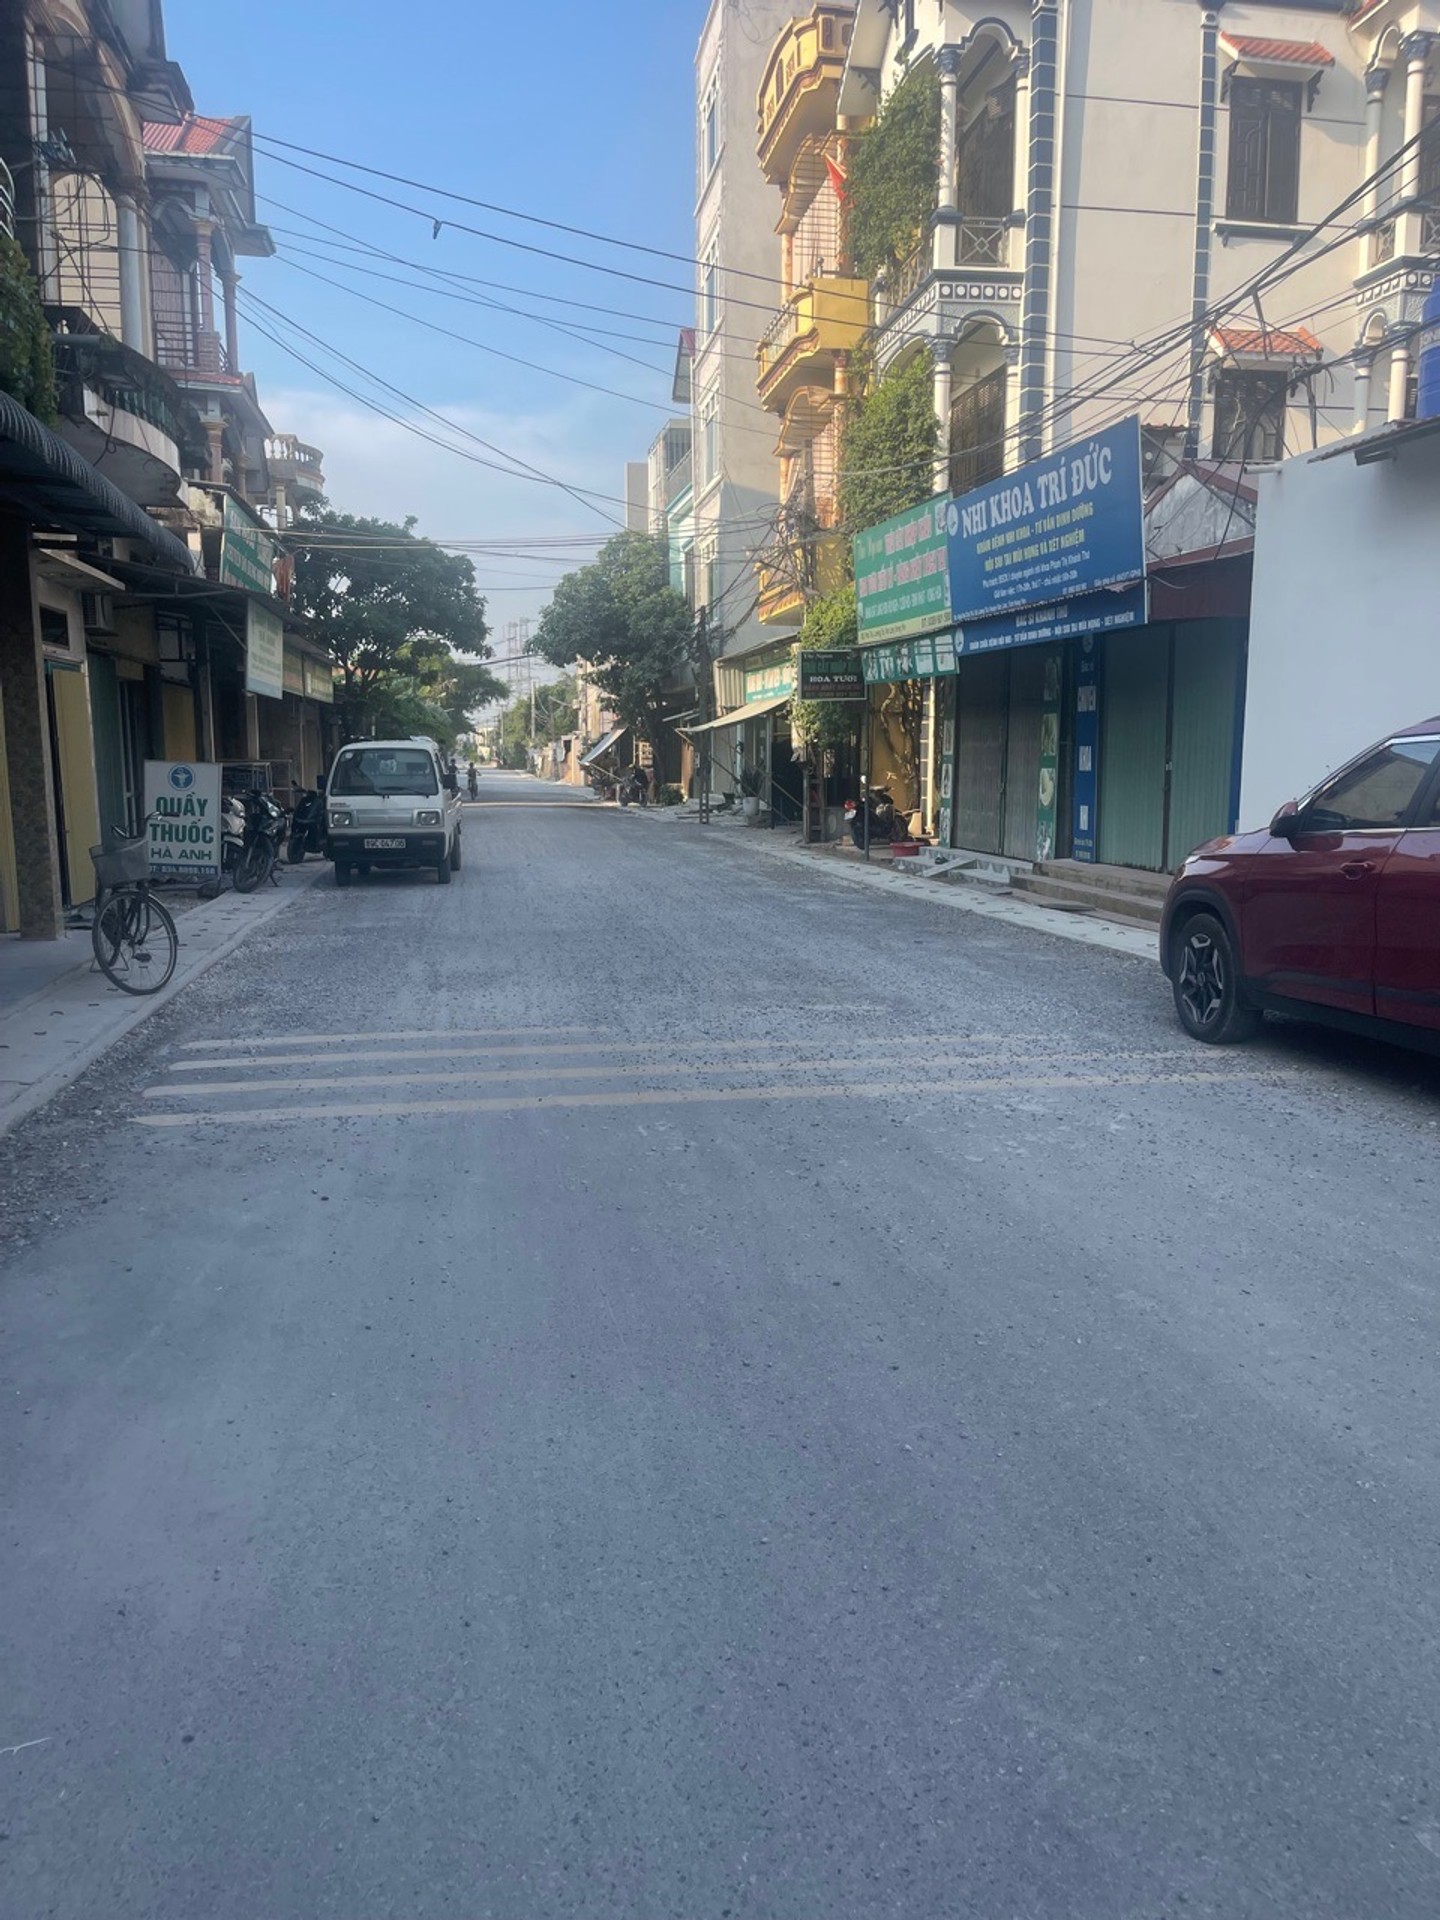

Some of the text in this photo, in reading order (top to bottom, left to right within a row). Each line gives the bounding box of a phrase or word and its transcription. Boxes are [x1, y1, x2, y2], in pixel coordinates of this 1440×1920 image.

[961, 500, 987, 538] NHI
[989, 482, 1035, 528] KHOA
[1036, 456, 1068, 509] TRÍ
[1071, 441, 1112, 497] ĐỨC
[809, 675, 831, 683] HOA
[156, 792, 208, 817] QUẦY
[149, 819, 214, 844] THUỐC
[151, 846, 212, 861] HÀ ANH
